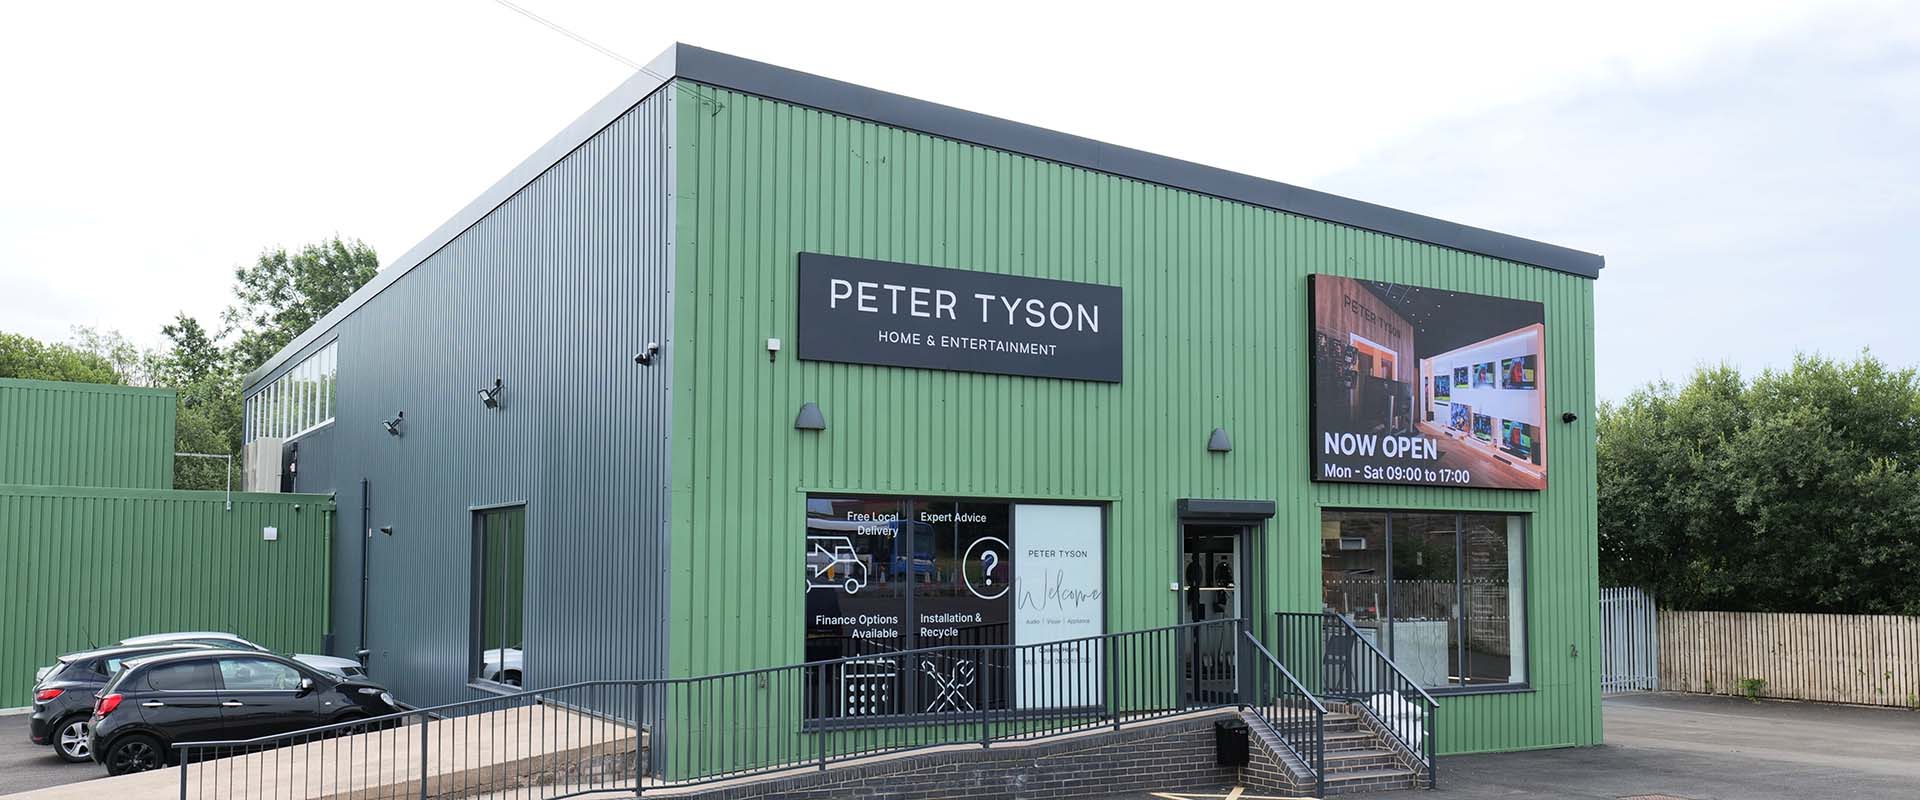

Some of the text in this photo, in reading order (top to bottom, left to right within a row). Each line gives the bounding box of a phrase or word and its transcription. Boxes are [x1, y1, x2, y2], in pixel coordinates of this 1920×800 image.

[831, 279, 1099, 333] PETER TYSON
[1344, 294, 1401, 339] PETER TYSON
[879, 330, 1057, 356] HOME & ENTERTAINMENT
[1324, 432, 1438, 460] NOW OPEN
[1324, 463, 1352, 479] Mon
[1364, 464, 1384, 480] Sat
[1386, 466, 1422, 482] 09:00
[1424, 468, 1437, 482] to
[1439, 468, 1470, 484] 17:00
[847, 511, 899, 522] Free Local
[920, 511, 987, 524] Expert Advice
[857, 525, 899, 538] Delivery
[1028, 550, 1088, 558] PETER TYSON
[1015, 568, 1103, 611] Welcome
[815, 614, 898, 627] Finance Options
[920, 612, 982, 623] Installation &
[851, 628, 898, 639] Available
[920, 627, 959, 639] Recycle
